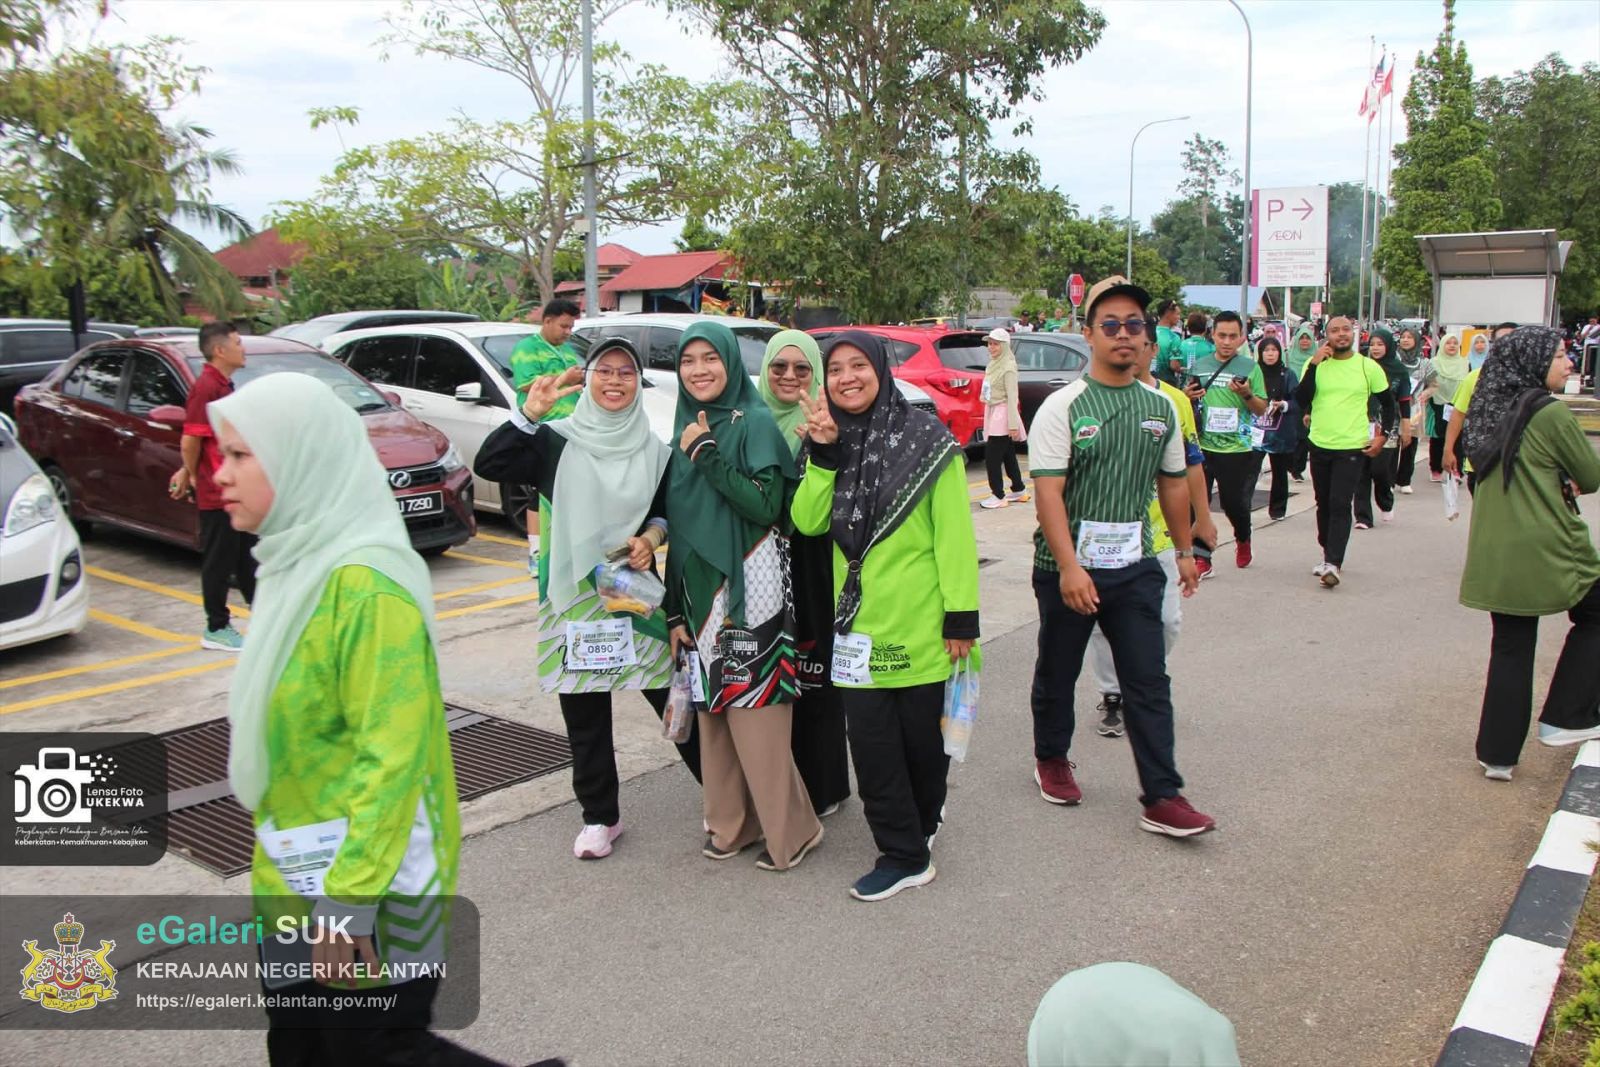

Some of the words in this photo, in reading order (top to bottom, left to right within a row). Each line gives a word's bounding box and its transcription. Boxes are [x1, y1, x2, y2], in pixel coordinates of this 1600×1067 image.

[1268, 199, 1285, 222] P
[405, 497, 432, 512] 7290
[587, 644, 614, 654] 0890
